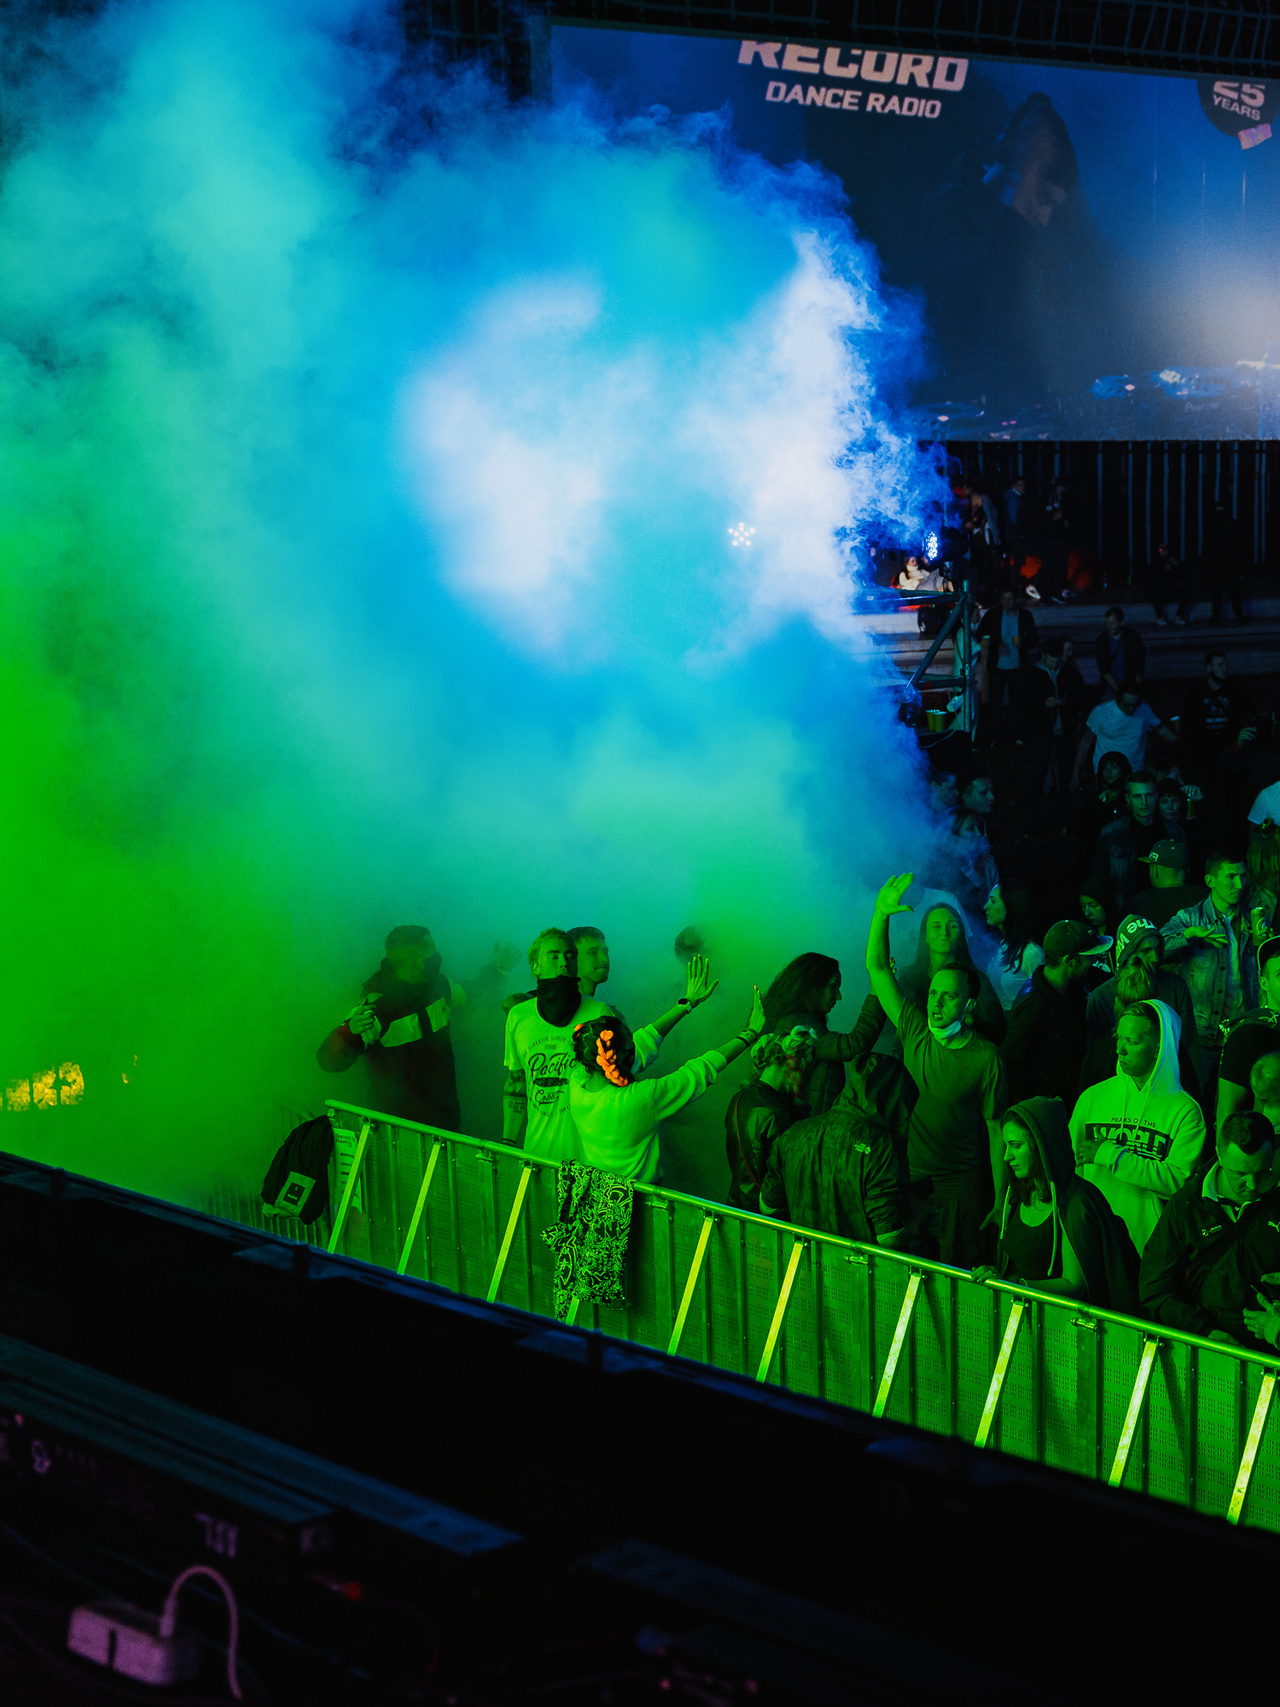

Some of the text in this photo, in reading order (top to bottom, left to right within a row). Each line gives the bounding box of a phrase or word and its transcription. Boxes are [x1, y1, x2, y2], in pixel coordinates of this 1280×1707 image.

[738, 39, 969, 92] RECORD
[765, 81, 942, 119] DANCE RADIO
[1213, 94, 1261, 121] YEARS
[528, 1052, 578, 1080] Pacific
[1144, 1120, 1157, 1128] THE
